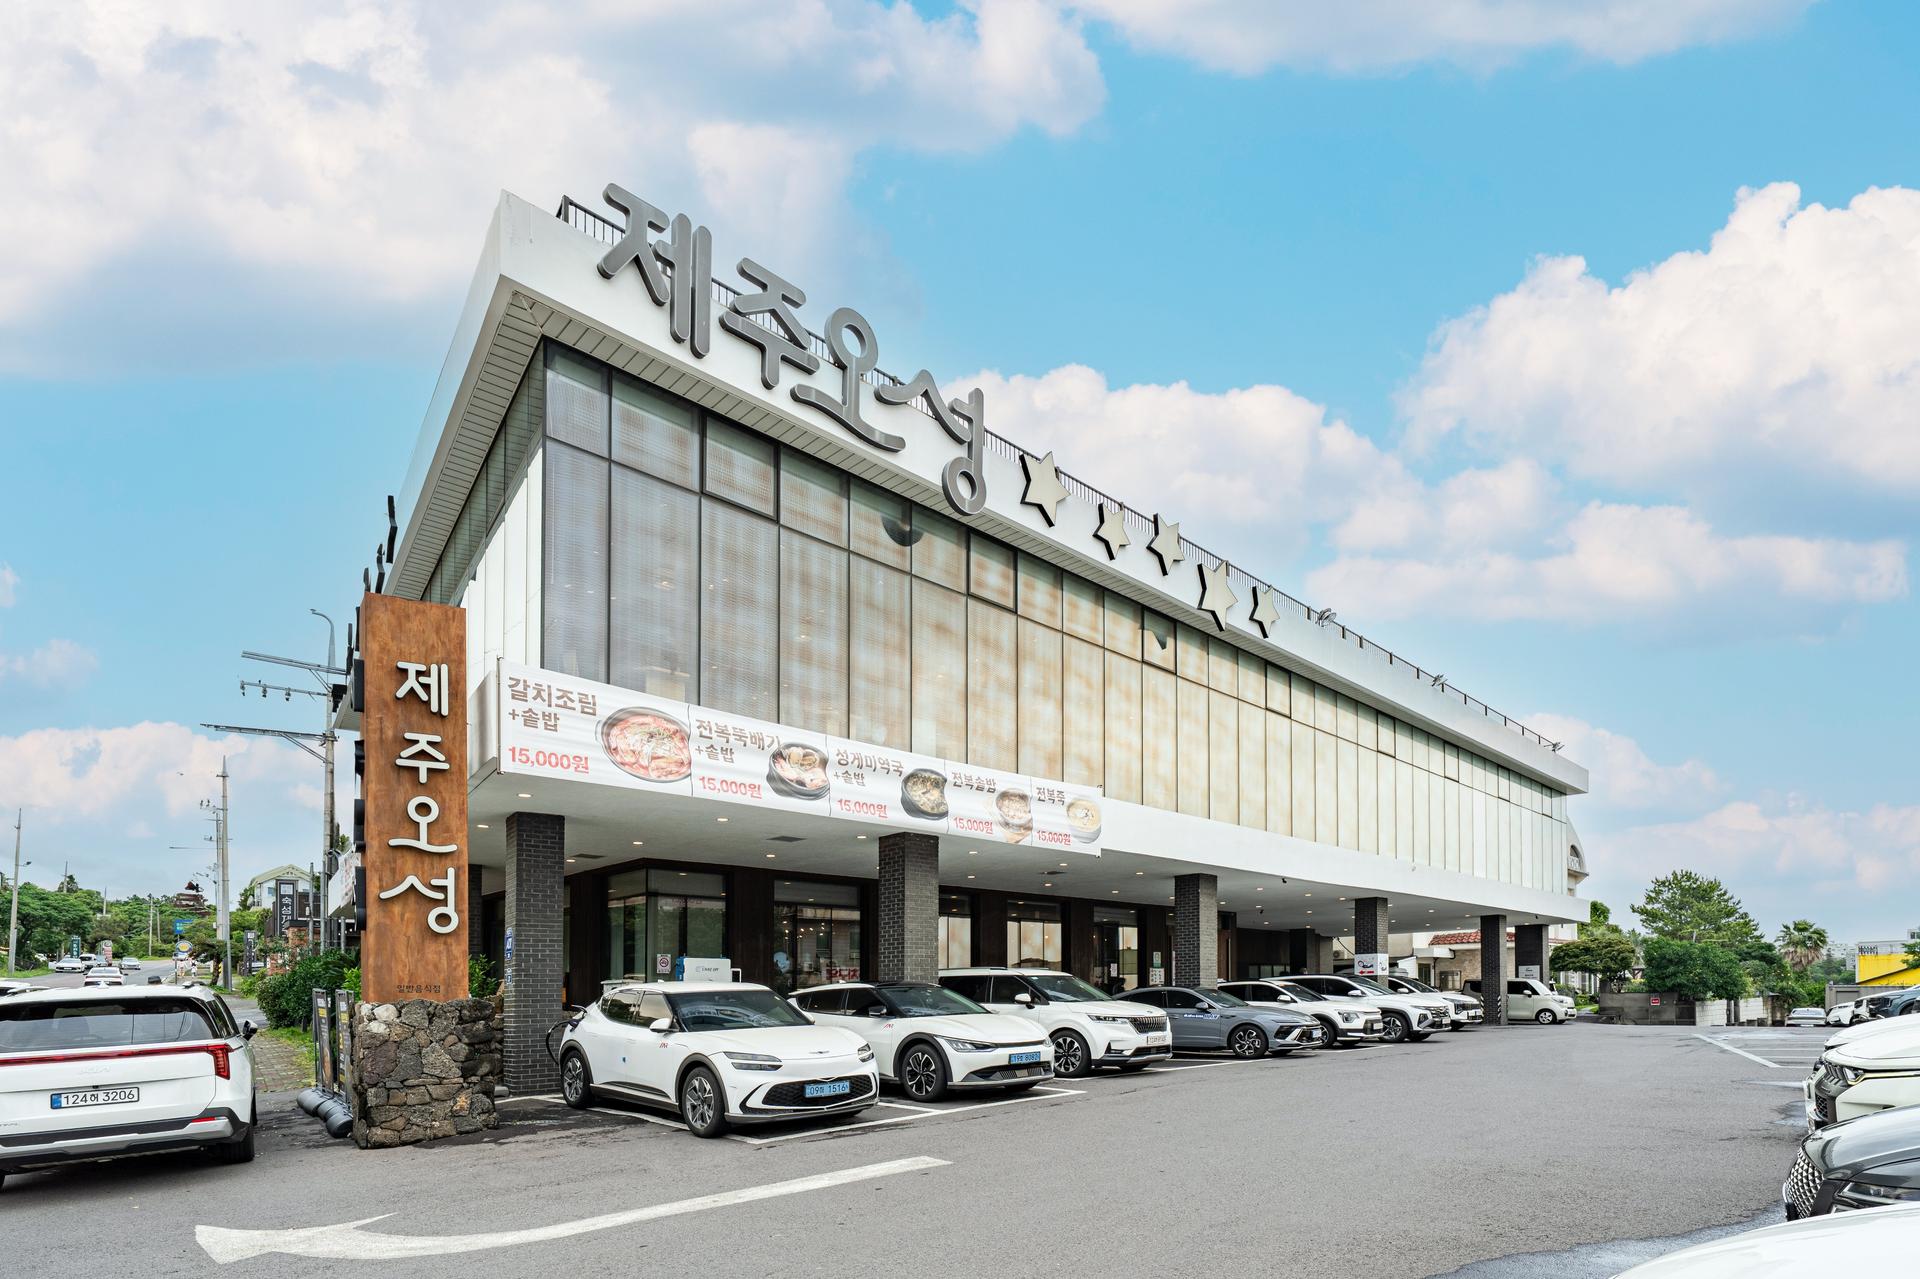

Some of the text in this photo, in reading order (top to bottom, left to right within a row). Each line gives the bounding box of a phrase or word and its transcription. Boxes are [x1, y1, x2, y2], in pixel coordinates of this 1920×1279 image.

[597, 182, 988, 517] 제주오성
[507, 675, 597, 717] 갈치조림
[508, 707, 560, 732] +솥밥
[695, 718, 782, 751] 전복뚝배기
[507, 745, 590, 774] 15,000원
[835, 748, 904, 777] 성게미역국
[699, 776, 762, 799] 15,000원
[951, 771, 997, 794] 전복솥밥
[377, 659, 461, 936] 제주오성
[1036, 786, 1066, 806] 전복죽
[837, 798, 889, 819] 15,000원
[953, 817, 994, 835] 15,000원
[1036, 830, 1072, 846] 15,000원
[63, 1090, 135, 1105] 124허 3206
